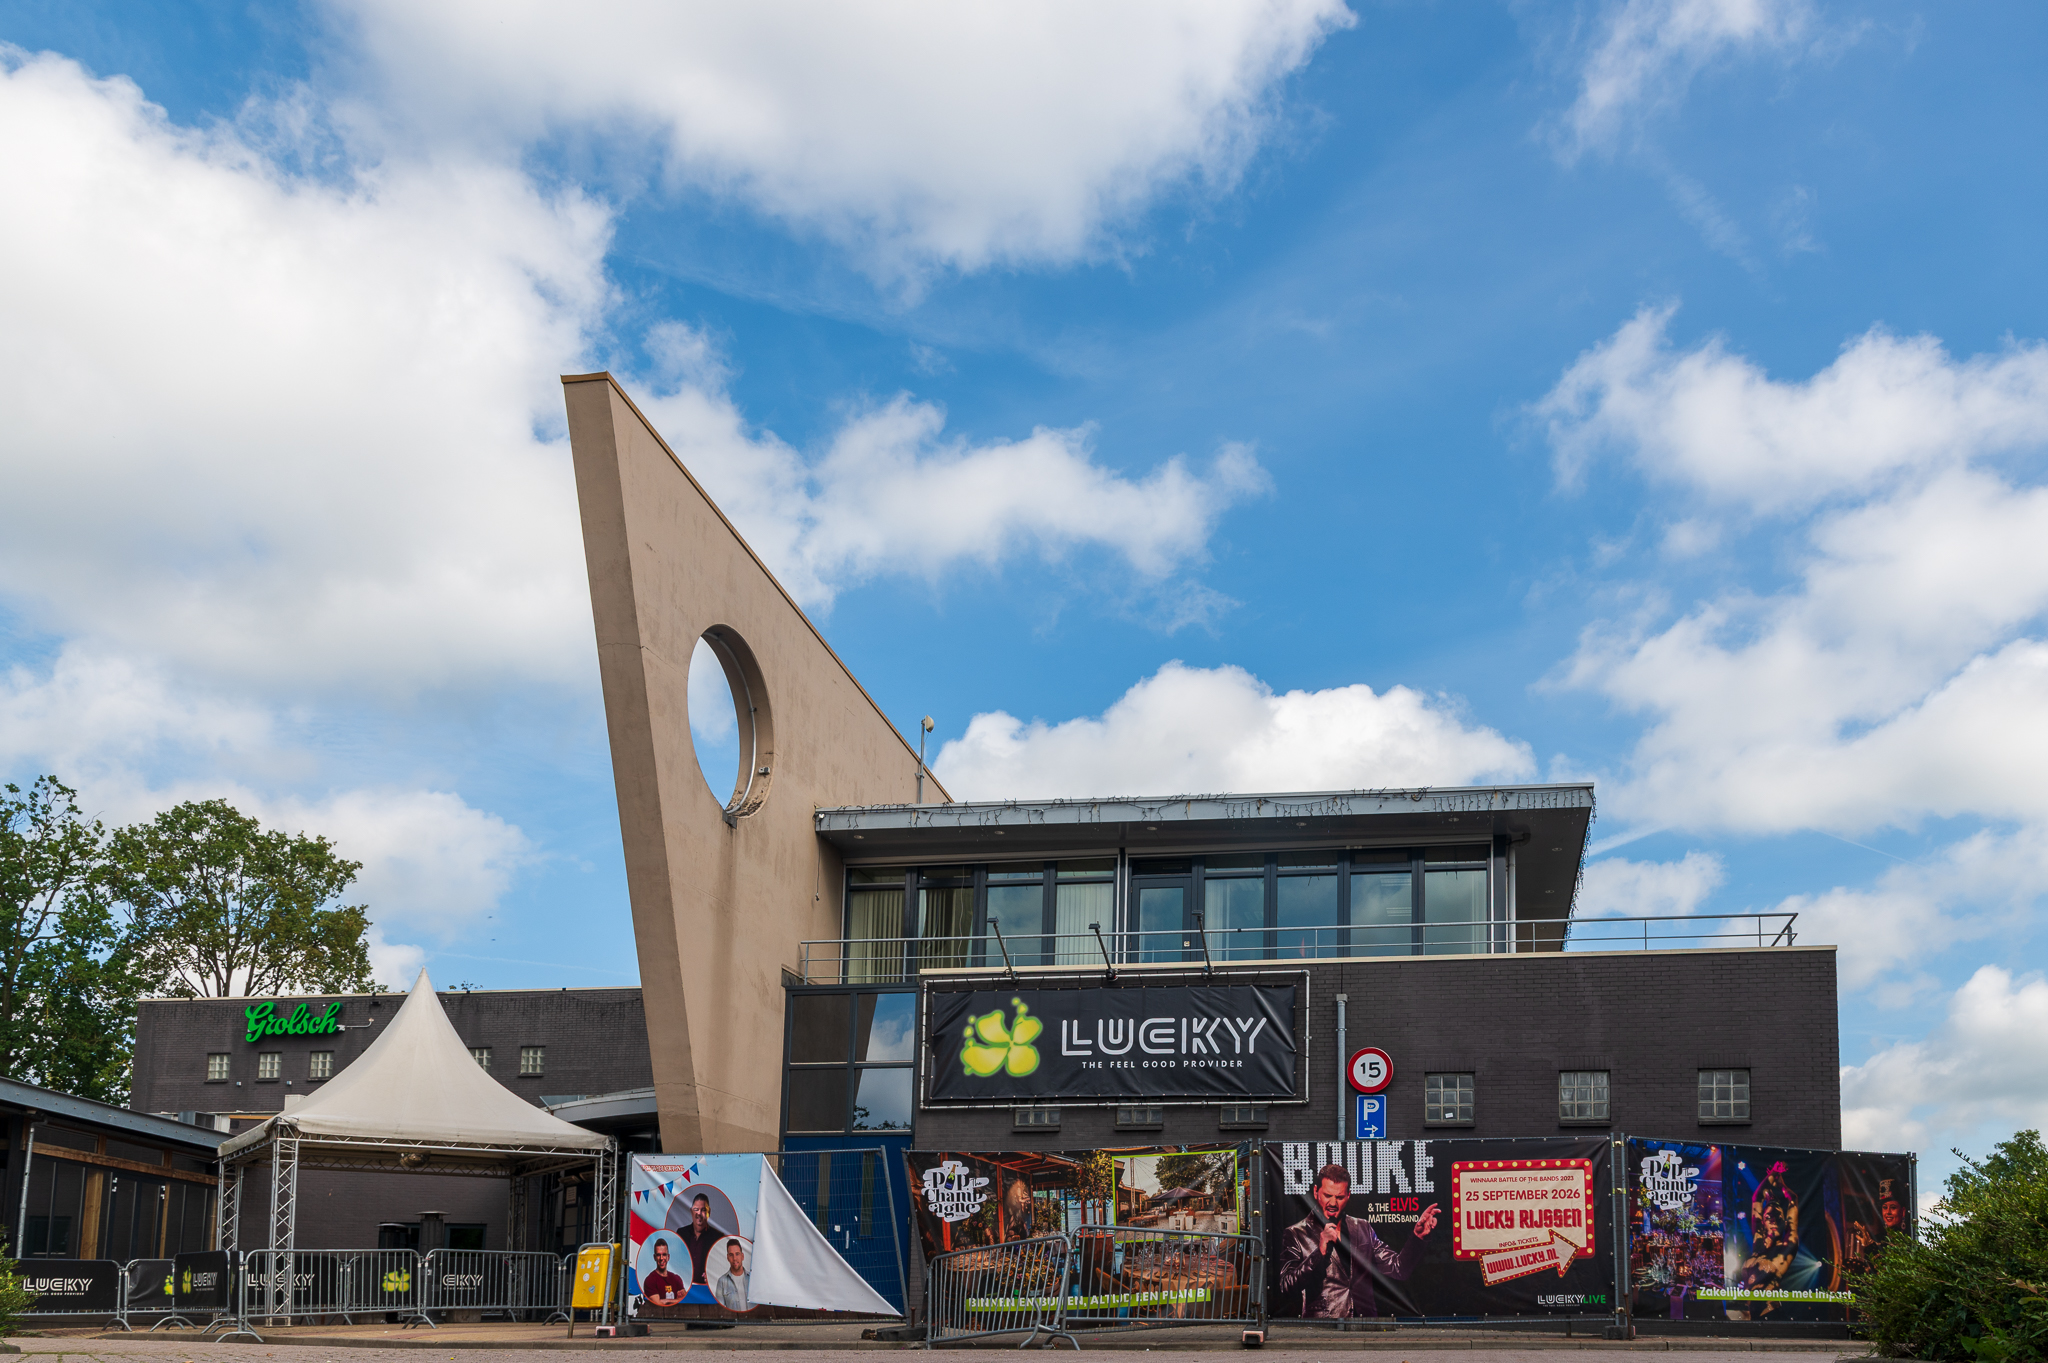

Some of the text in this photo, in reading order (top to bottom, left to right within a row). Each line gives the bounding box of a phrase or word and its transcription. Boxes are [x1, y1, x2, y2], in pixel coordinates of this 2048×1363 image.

[244, 1001, 339, 1042] Grolsch
[1061, 1017, 1267, 1056] LUCKY
[1082, 1060, 1244, 1069] THE FEEL GOOD PROVIDER
[1360, 1062, 1381, 1078] 15
[1364, 1099, 1379, 1120] P
[1465, 1188, 1580, 1201] 25 SEPTEMBER 2026
[1368, 1197, 1419, 1212] & THE ELVIS
[1368, 1214, 1420, 1223] MATTERS BAND
[1466, 1210, 1515, 1230] LUCKY
[1517, 1236, 1539, 1245] TICKETS
[23, 1278, 93, 1291] LUCKY
[193, 1272, 218, 1287] LUCKY
[969, 1288, 1205, 1307] BINNEN EN BUIEN, ALTIJD EEN PLAN B
[1699, 1286, 1751, 1300] Zakelijke
[1753, 1288, 1789, 1298] events
[1791, 1289, 1812, 1299] met
